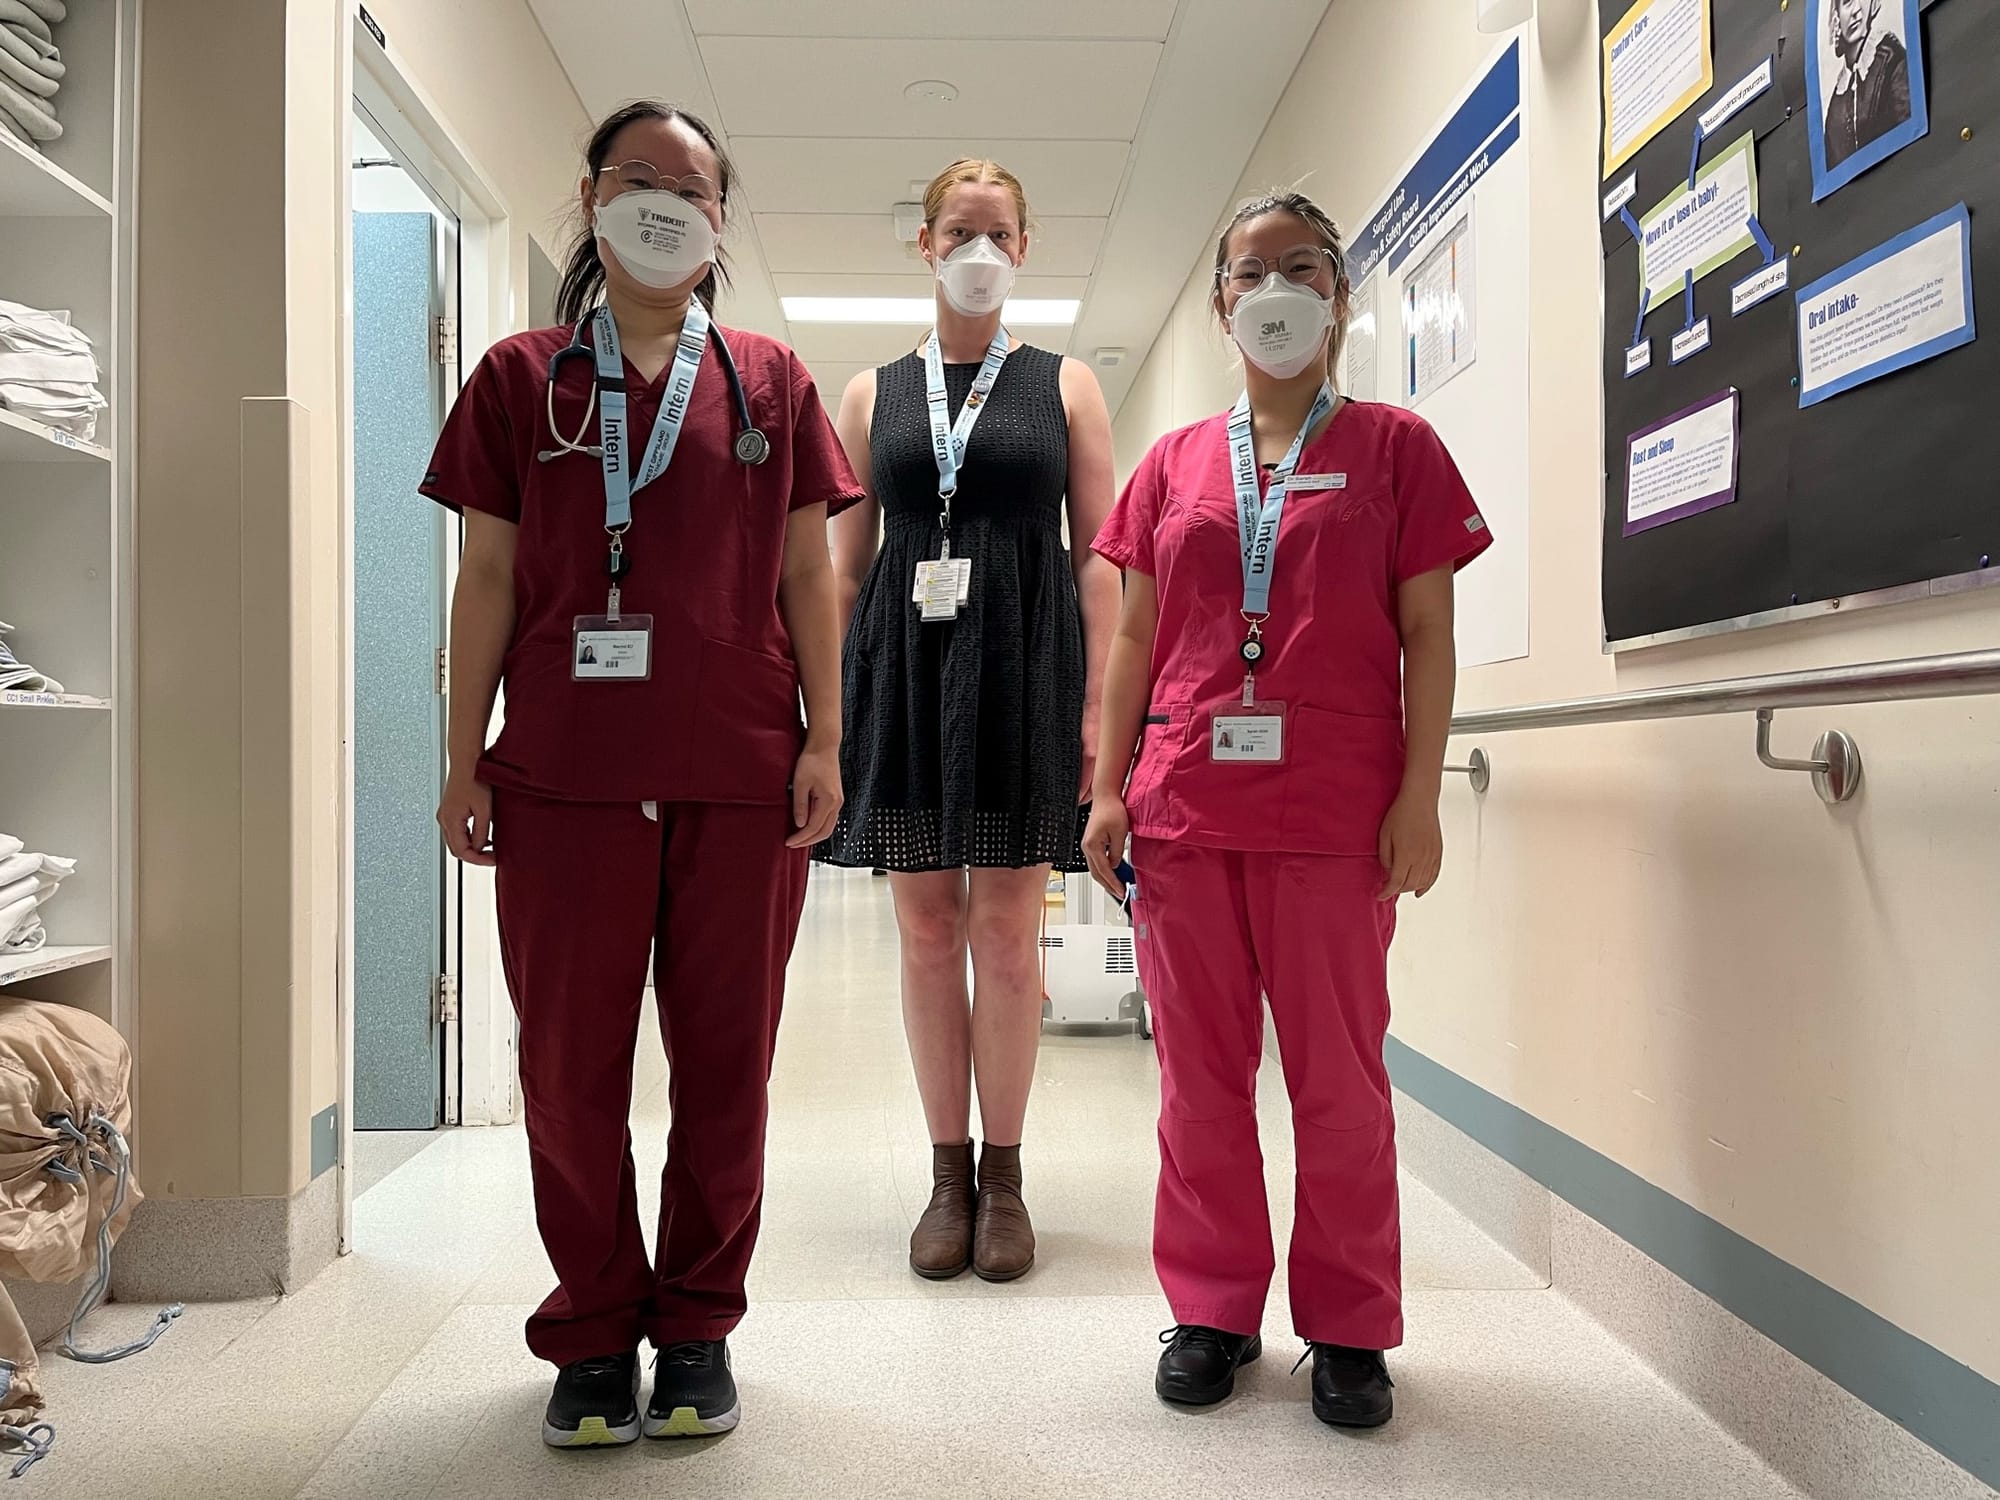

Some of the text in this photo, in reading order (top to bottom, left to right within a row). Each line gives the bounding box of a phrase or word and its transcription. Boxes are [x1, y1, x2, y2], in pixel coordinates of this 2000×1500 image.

[651, 212, 686, 228] TRIDENT
[1372, 188, 1406, 238] Surgical Unit
[1409, 152, 1489, 248] Quality Improvement Work
[1645, 227, 1660, 249] Move
[1661, 219, 1667, 236] it
[1668, 214, 1675, 231] or
[1676, 204, 1690, 224] lose
[1691, 197, 1698, 214] it
[1360, 247, 1379, 275] Quality
[1379, 238, 1385, 254] &
[1385, 220, 1401, 248] Safety
[1401, 193, 1419, 228] Board
[1261, 320, 1286, 335] 3M
[1808, 293, 1859, 330] Oral intake-
[662, 377, 690, 424] Intern
[604, 418, 622, 473] Intern
[935, 422, 949, 462] Intern
[1238, 443, 1254, 486] Intern
[1633, 448, 1646, 466] Rest
[1647, 442, 1658, 460] and
[1659, 437, 1675, 455] Sleep
[1251, 520, 1276, 575] Intern
